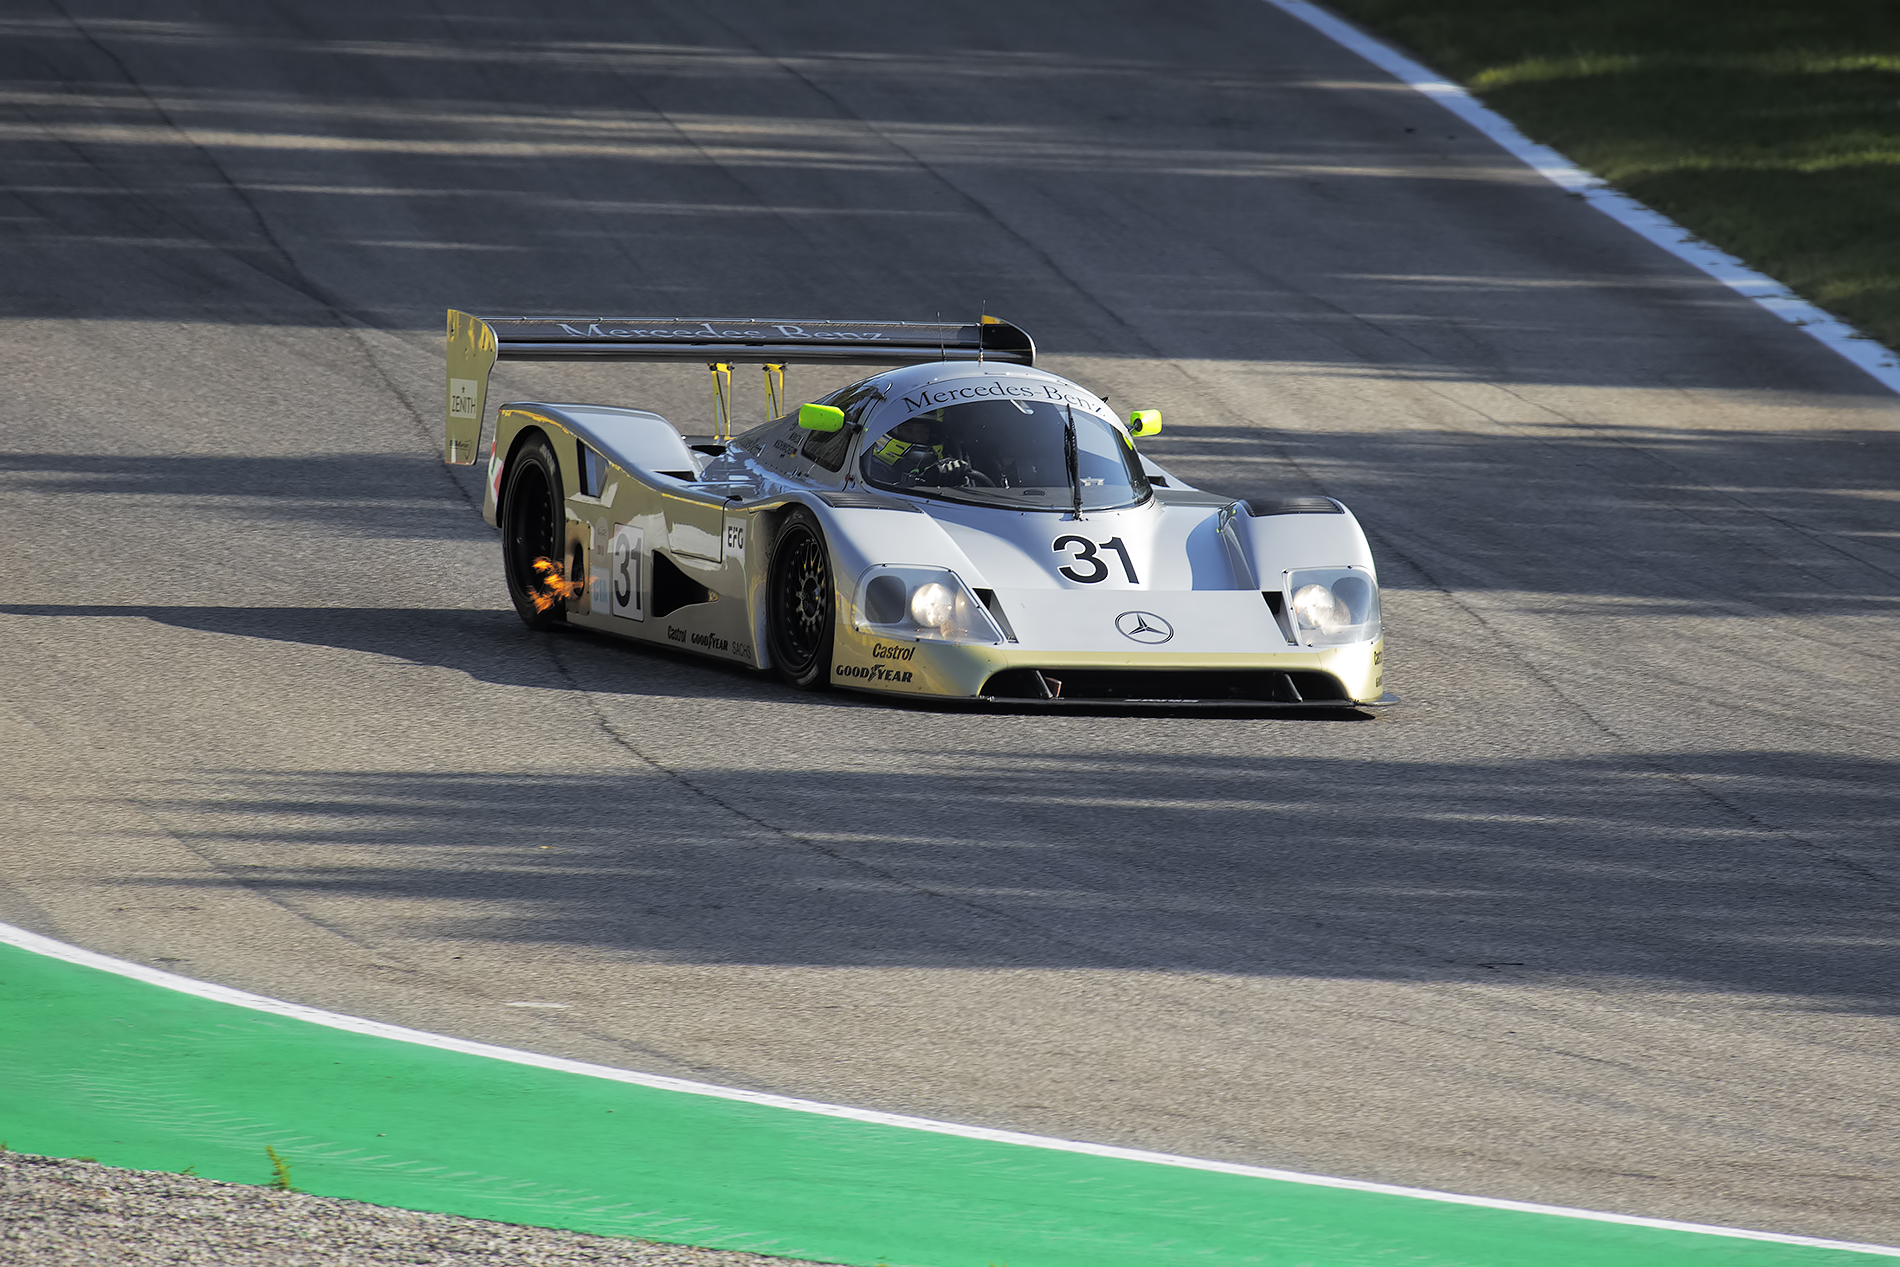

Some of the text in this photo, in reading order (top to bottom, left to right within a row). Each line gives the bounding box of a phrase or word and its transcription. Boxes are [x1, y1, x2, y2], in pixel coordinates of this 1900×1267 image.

[557, 322, 891, 342] Mercedes Benz
[614, 533, 643, 611] 31
[1052, 534, 1140, 585] 31
[667, 625, 688, 643] Castrol
[731, 641, 752, 659] SACHS
[872, 642, 917, 661] Castrol
[835, 663, 914, 683] GOODYEAR
